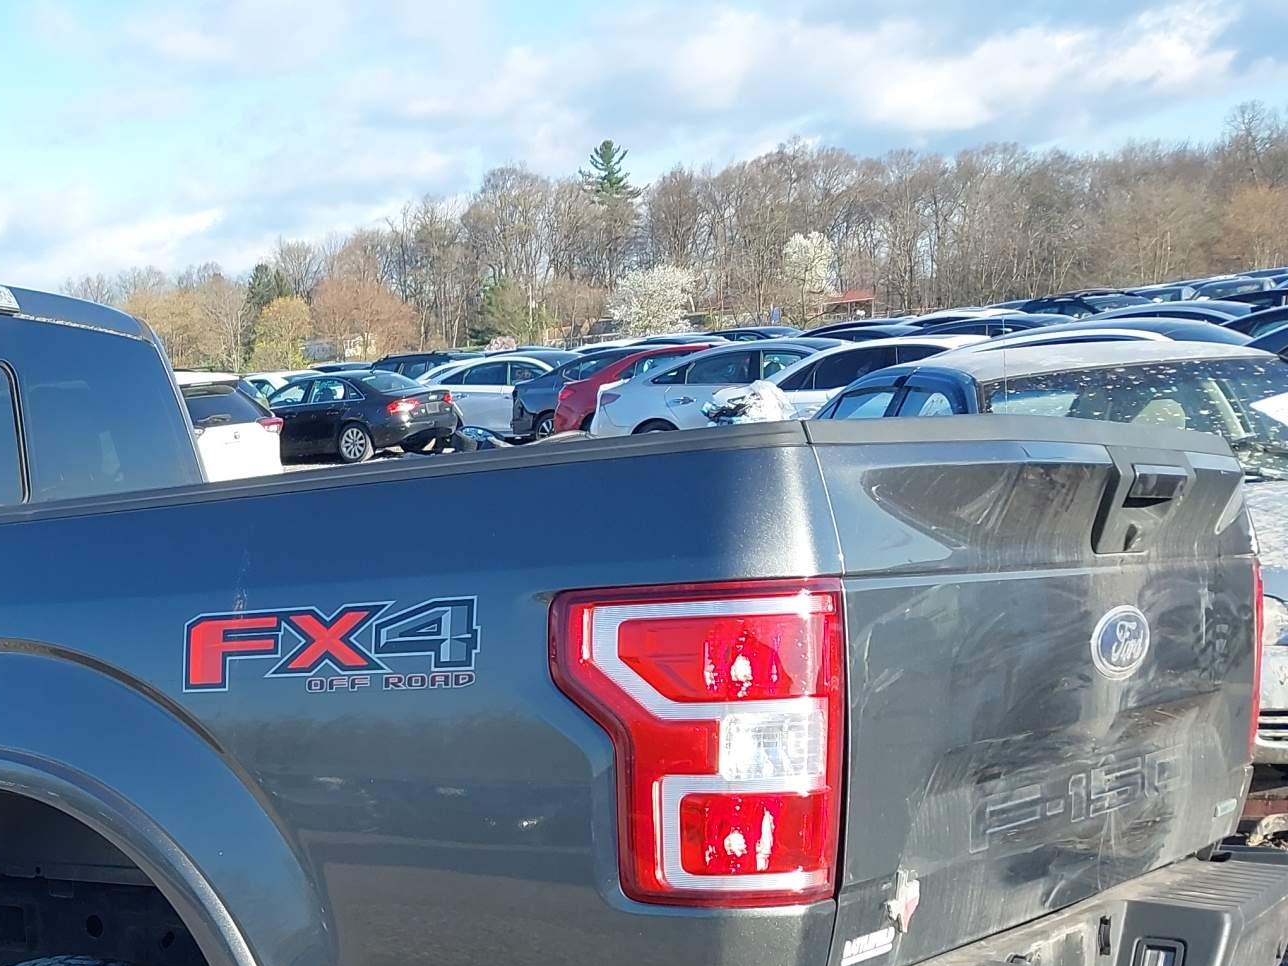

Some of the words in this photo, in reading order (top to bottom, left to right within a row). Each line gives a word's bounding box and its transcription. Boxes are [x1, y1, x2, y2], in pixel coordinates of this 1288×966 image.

[183, 595, 481, 693] FX4
[305, 675, 371, 694] OFF
[383, 671, 476, 690] ROAD
